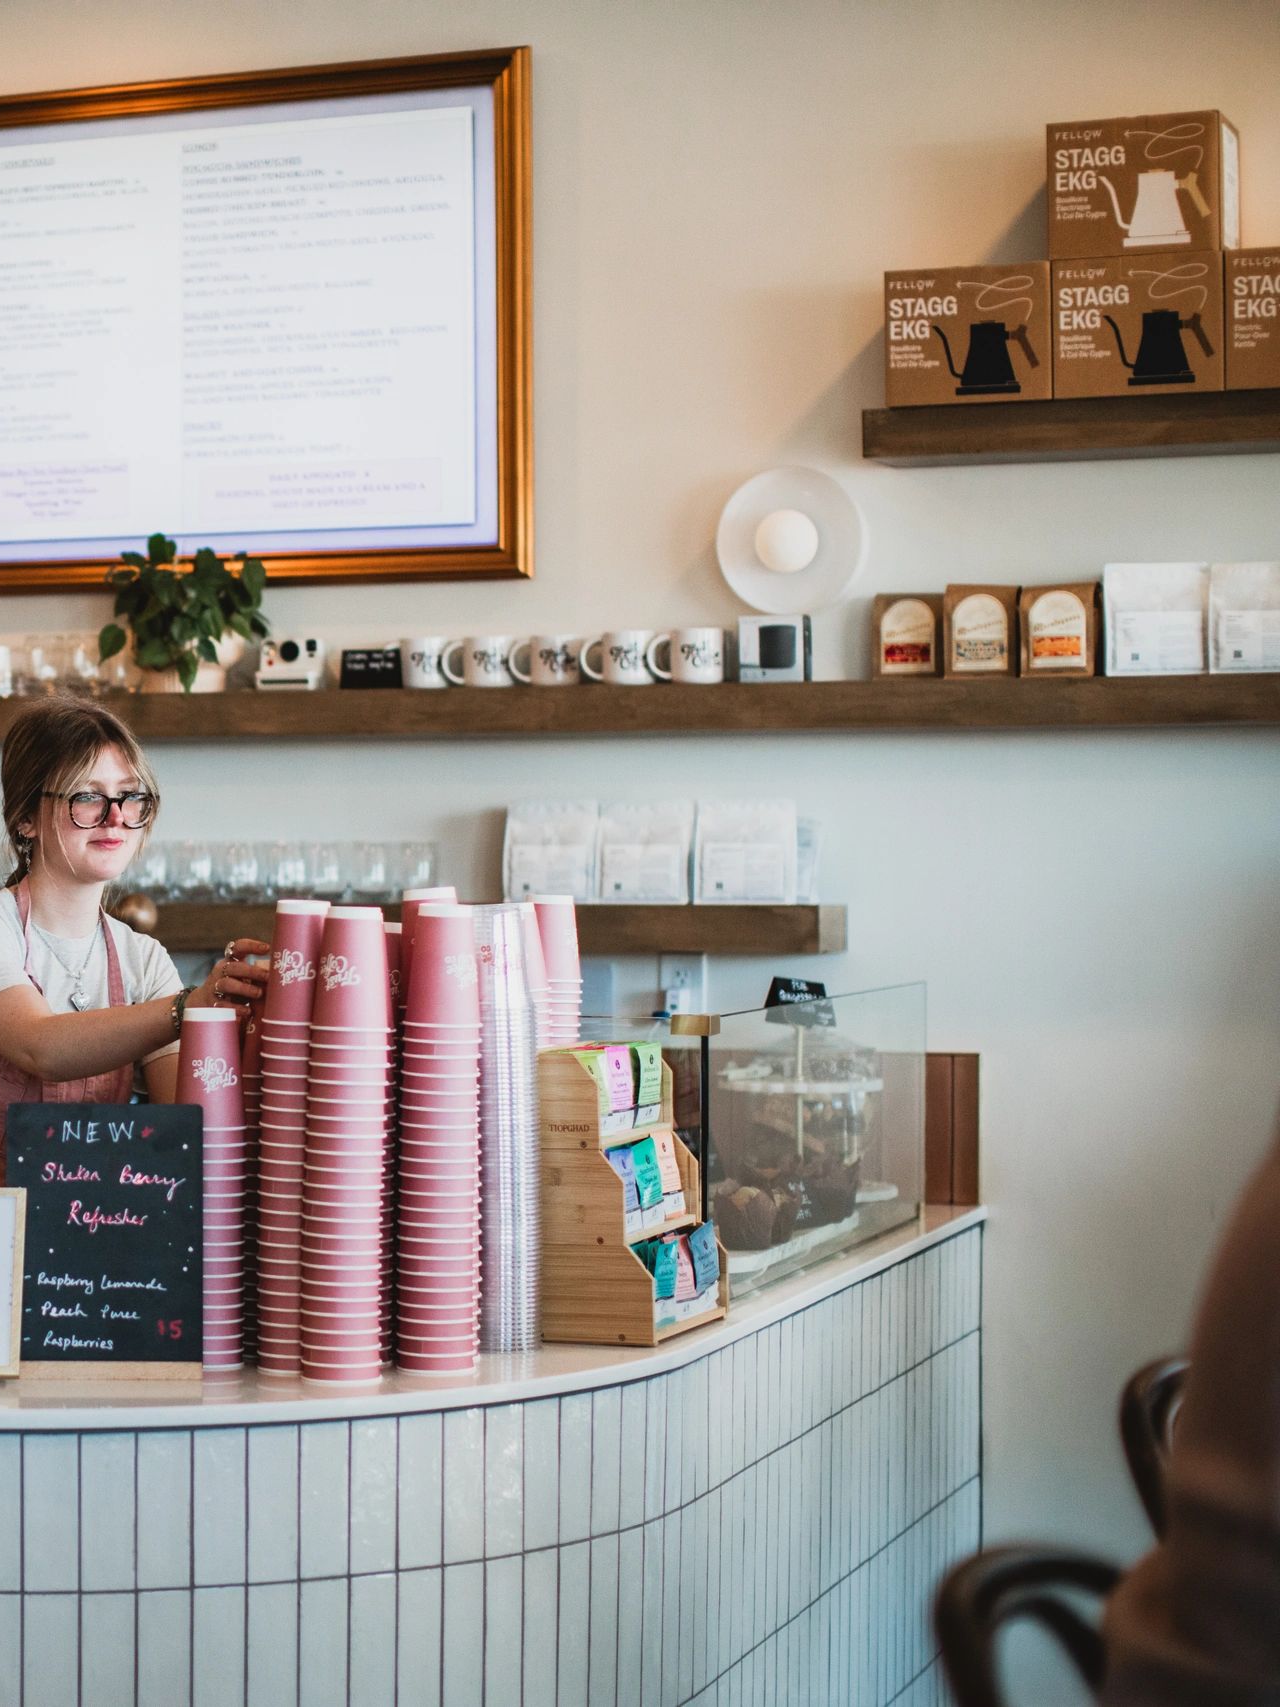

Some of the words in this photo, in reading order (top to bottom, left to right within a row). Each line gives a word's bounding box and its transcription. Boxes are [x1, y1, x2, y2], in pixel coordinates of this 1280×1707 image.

[1055, 145, 1126, 169] STAGG
[1056, 170, 1097, 192] EKG
[889, 296, 958, 319] STAGG
[1059, 284, 1130, 308] STAGG
[1060, 308, 1101, 331] EKG
[1234, 297, 1277, 319] EKG
[890, 319, 930, 341] EKG
[280, 961, 316, 986] Trust
[325, 966, 361, 992] Trust
[193, 1056, 227, 1081] Coffee
[204, 1067, 237, 1093] Trust
[61, 1120, 134, 1142] NEW
[41, 1162, 101, 1182] Shaken
[119, 1164, 186, 1200] Berry
[67, 1200, 148, 1233] Refresher
[37, 1272, 94, 1294] Raspberry
[101, 1275, 167, 1291] Lemonade
[41, 1301, 88, 1318] Peach
[101, 1304, 141, 1319] Puree
[44, 1331, 114, 1350] Raspberries
